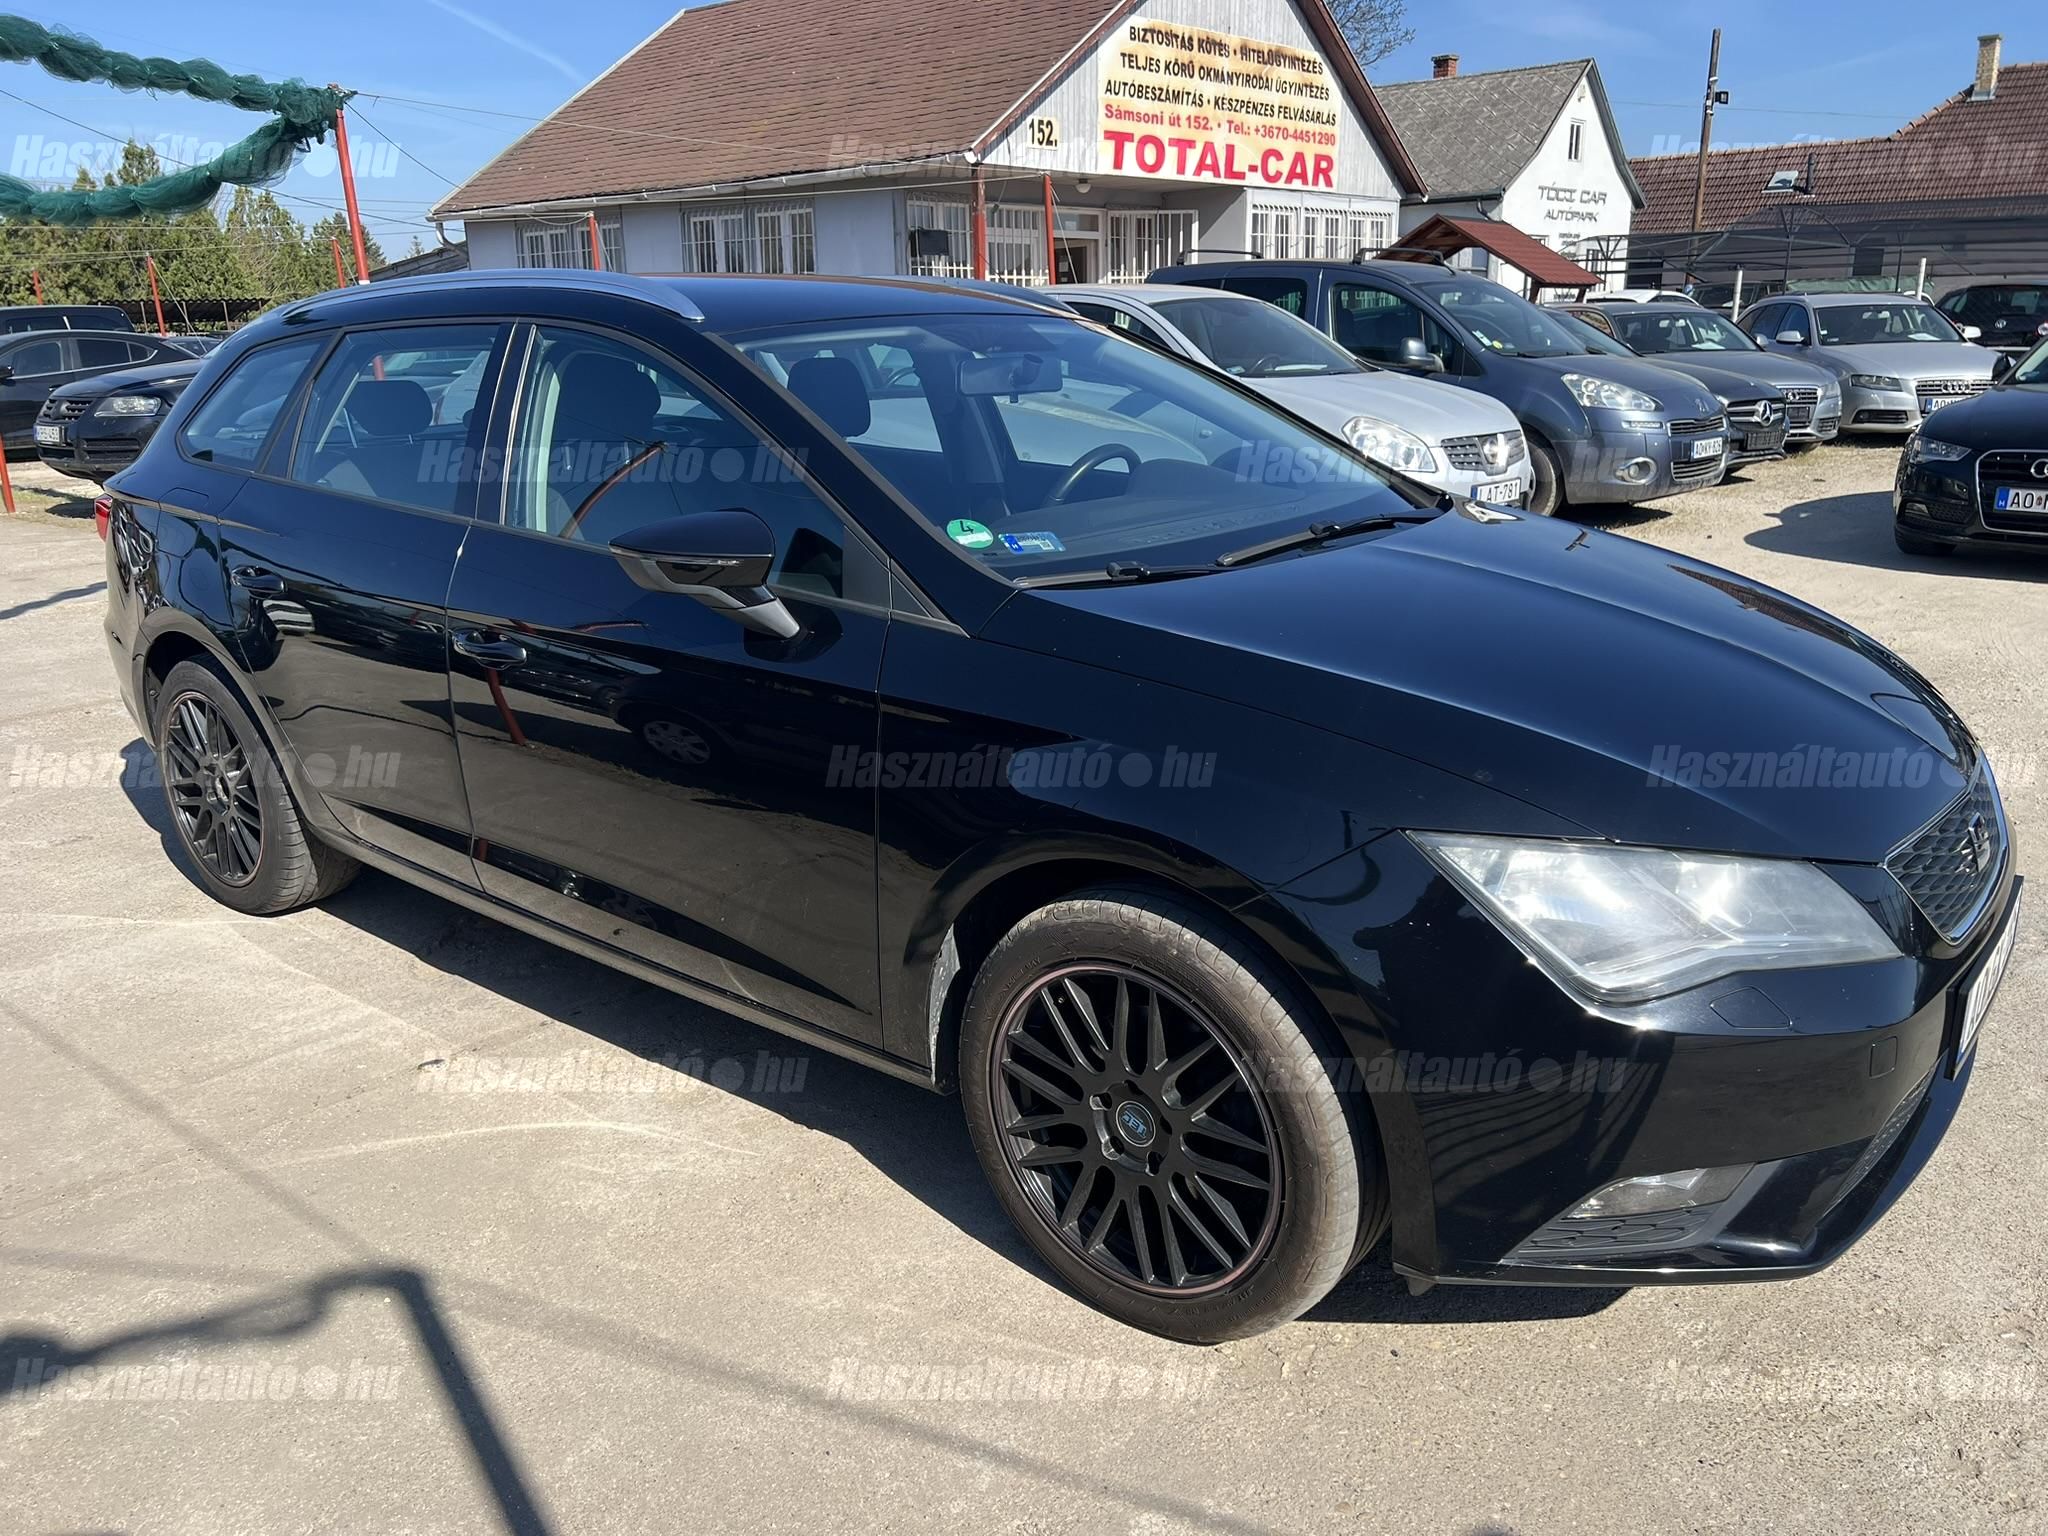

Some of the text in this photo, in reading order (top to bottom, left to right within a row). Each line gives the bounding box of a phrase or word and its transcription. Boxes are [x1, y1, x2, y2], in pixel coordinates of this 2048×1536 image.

[1129, 26, 1194, 52] BIZTOSÍTÁS
[1120, 52, 1161, 74] TELJES
[1198, 65, 1273, 92] OKMÁNYIRODAI
[1275, 76, 1330, 101] ÜGYINTÉZÉS
[1105, 79, 1337, 127] AUTÓBESZÁMÍTÁS KÉSZPÉNZES FELVÁSÁRLÁS
[1029, 118, 1058, 147] 152.
[1104, 103, 1336, 146] Sámsoni út 152. Tel.: +3670-4451290
[1103, 130, 1334, 188] TOTAL-CAR
[1579, 189, 1608, 206] CAR
[2010, 492, 2035, 509] AO
